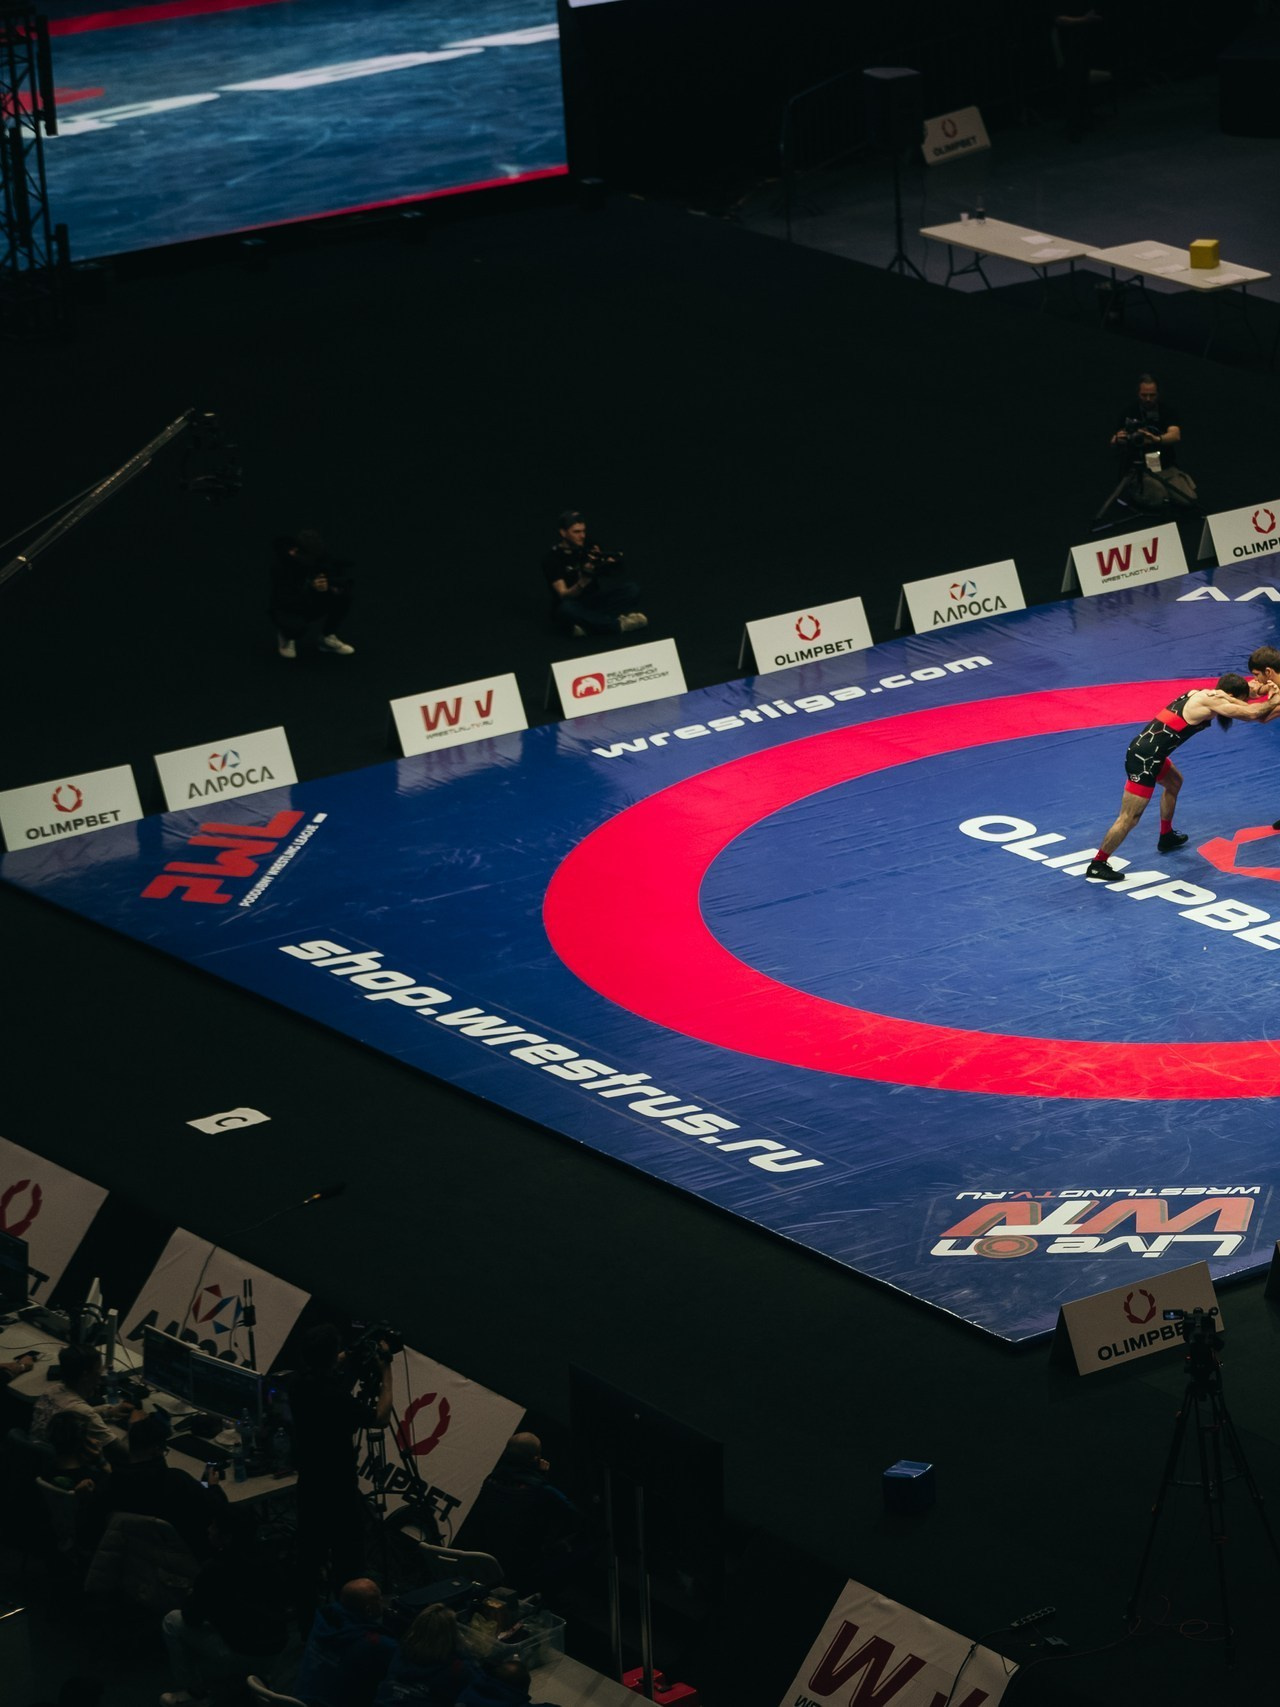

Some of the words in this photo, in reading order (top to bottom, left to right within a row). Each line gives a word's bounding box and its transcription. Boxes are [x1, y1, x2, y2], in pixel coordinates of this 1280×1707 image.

[774, 638, 854, 667] OLIMPBET
[591, 655, 994, 759] wrestliga.com
[25, 809, 121, 841] OLIMPBET
[278, 939, 825, 1173] shop.wrestrus.ru
[956, 1186, 1261, 1201] WRESTLINGTV.RU
[1097, 1320, 1185, 1362] OLIMPBE
